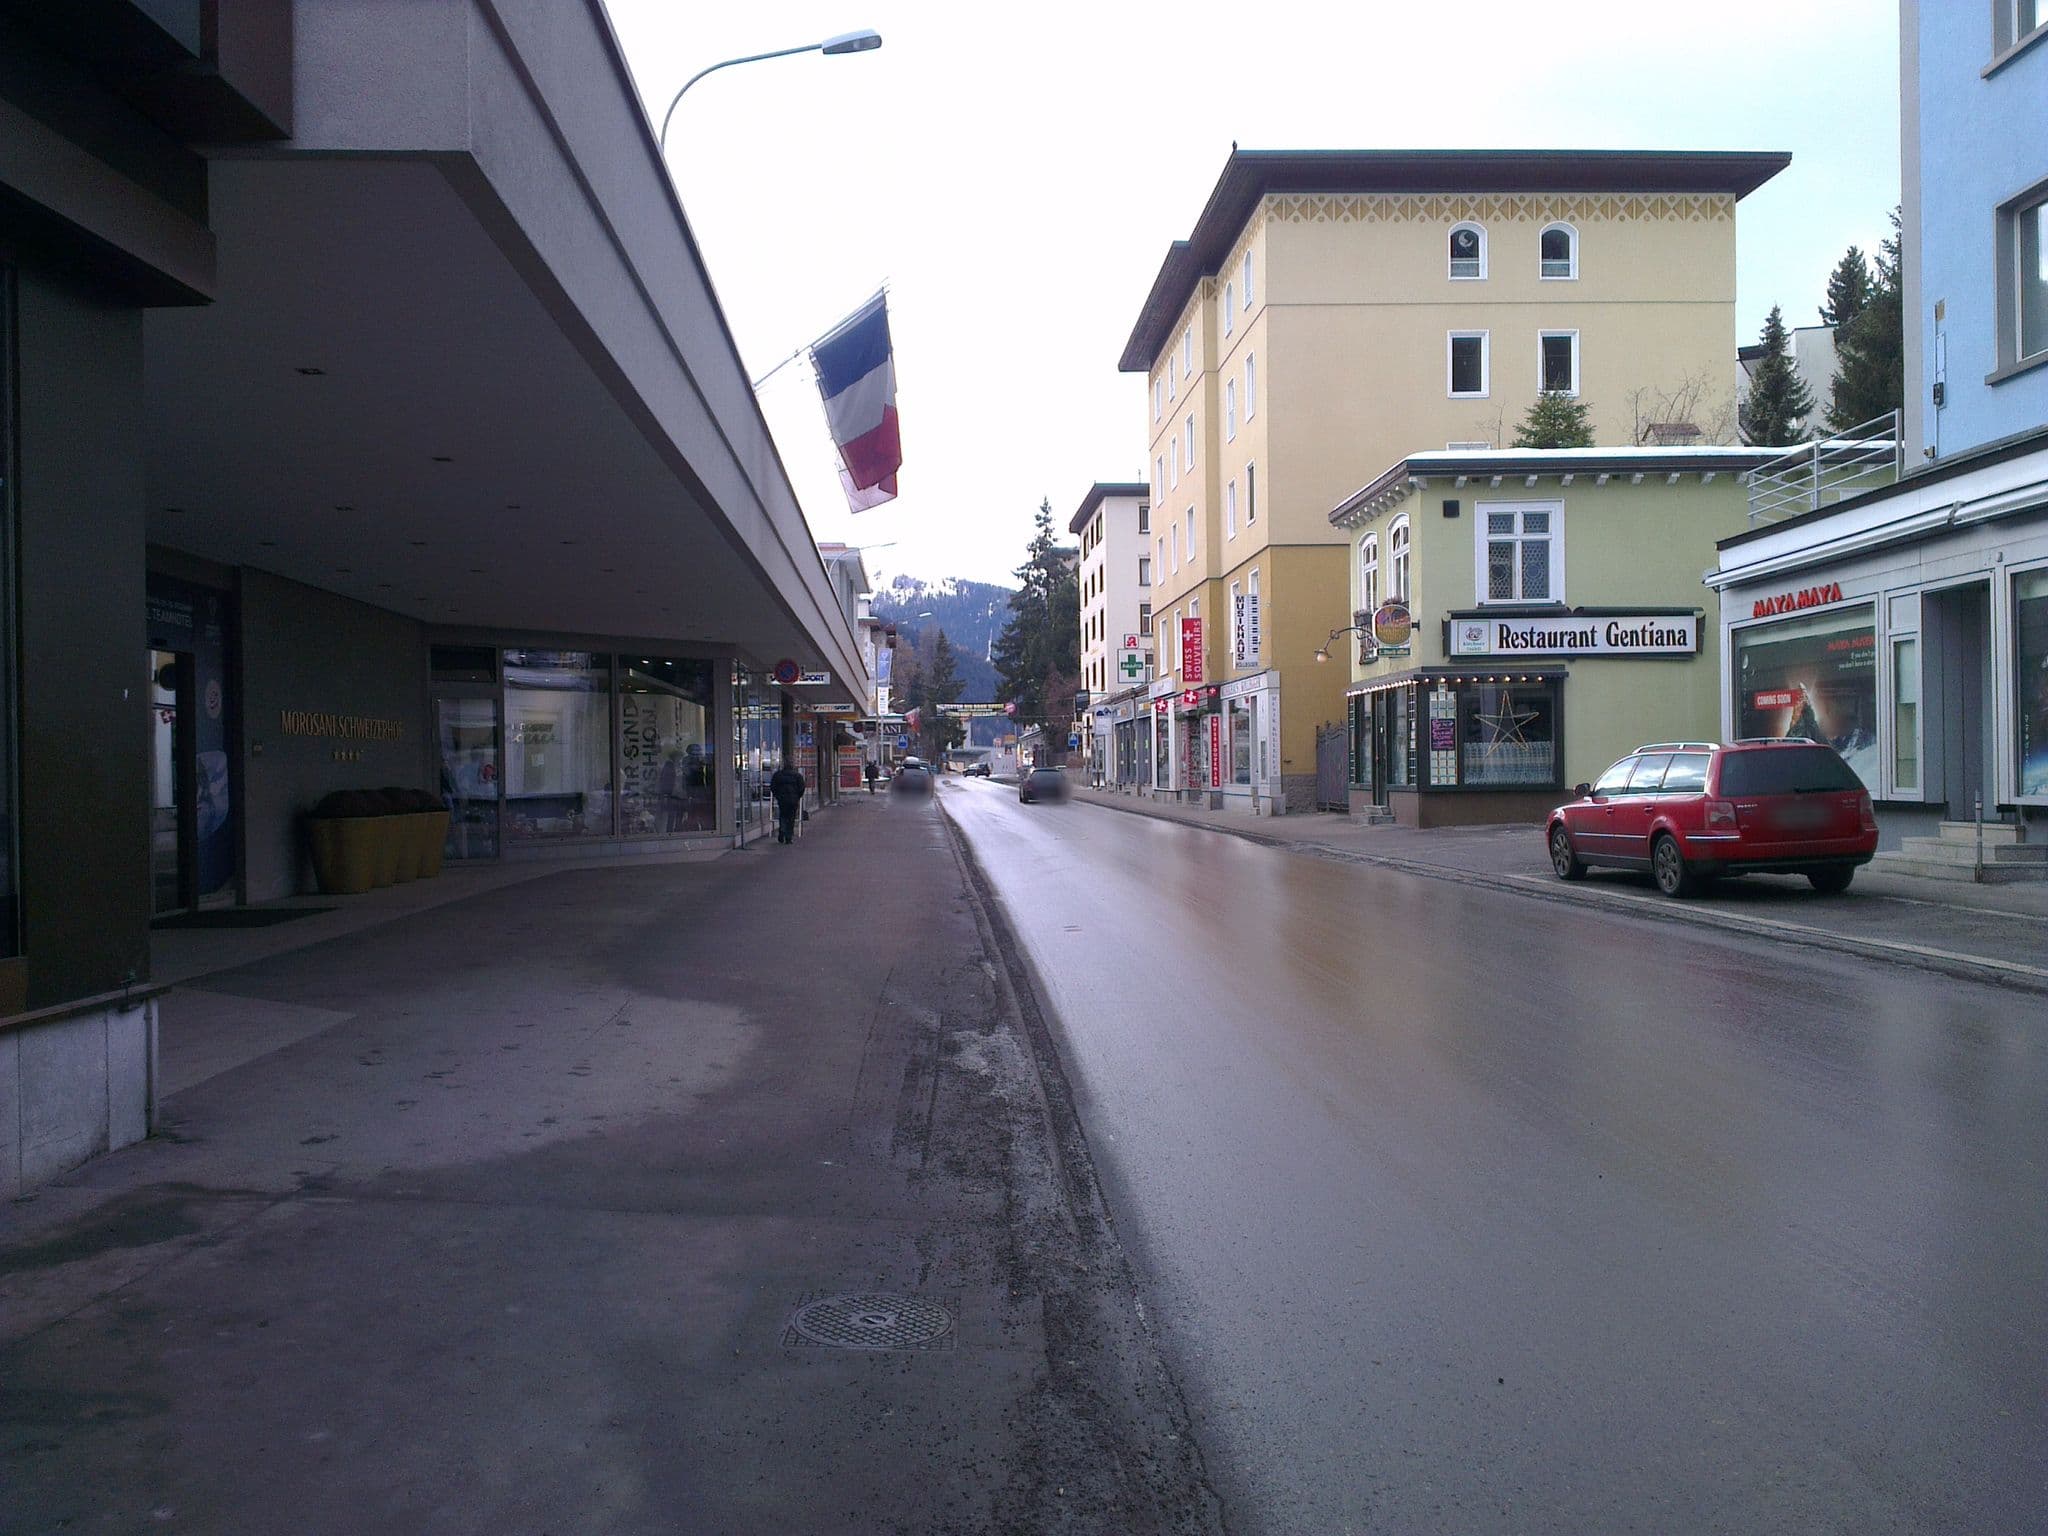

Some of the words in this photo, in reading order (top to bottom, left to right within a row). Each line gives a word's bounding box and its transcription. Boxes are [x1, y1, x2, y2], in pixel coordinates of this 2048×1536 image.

[1236, 596, 1245, 660] MUSIKHAUS
[1498, 624, 1597, 649] Restaurant
[1605, 621, 1688, 648] Gentiana
[1185, 648, 1193, 679] SWISS
[1194, 620, 1202, 679] SOUVENIRS
[1777, 693, 1792, 705] SOON
[280, 710, 336, 737] MOROSANI
[338, 715, 404, 742] SCHWEIZERHOF
